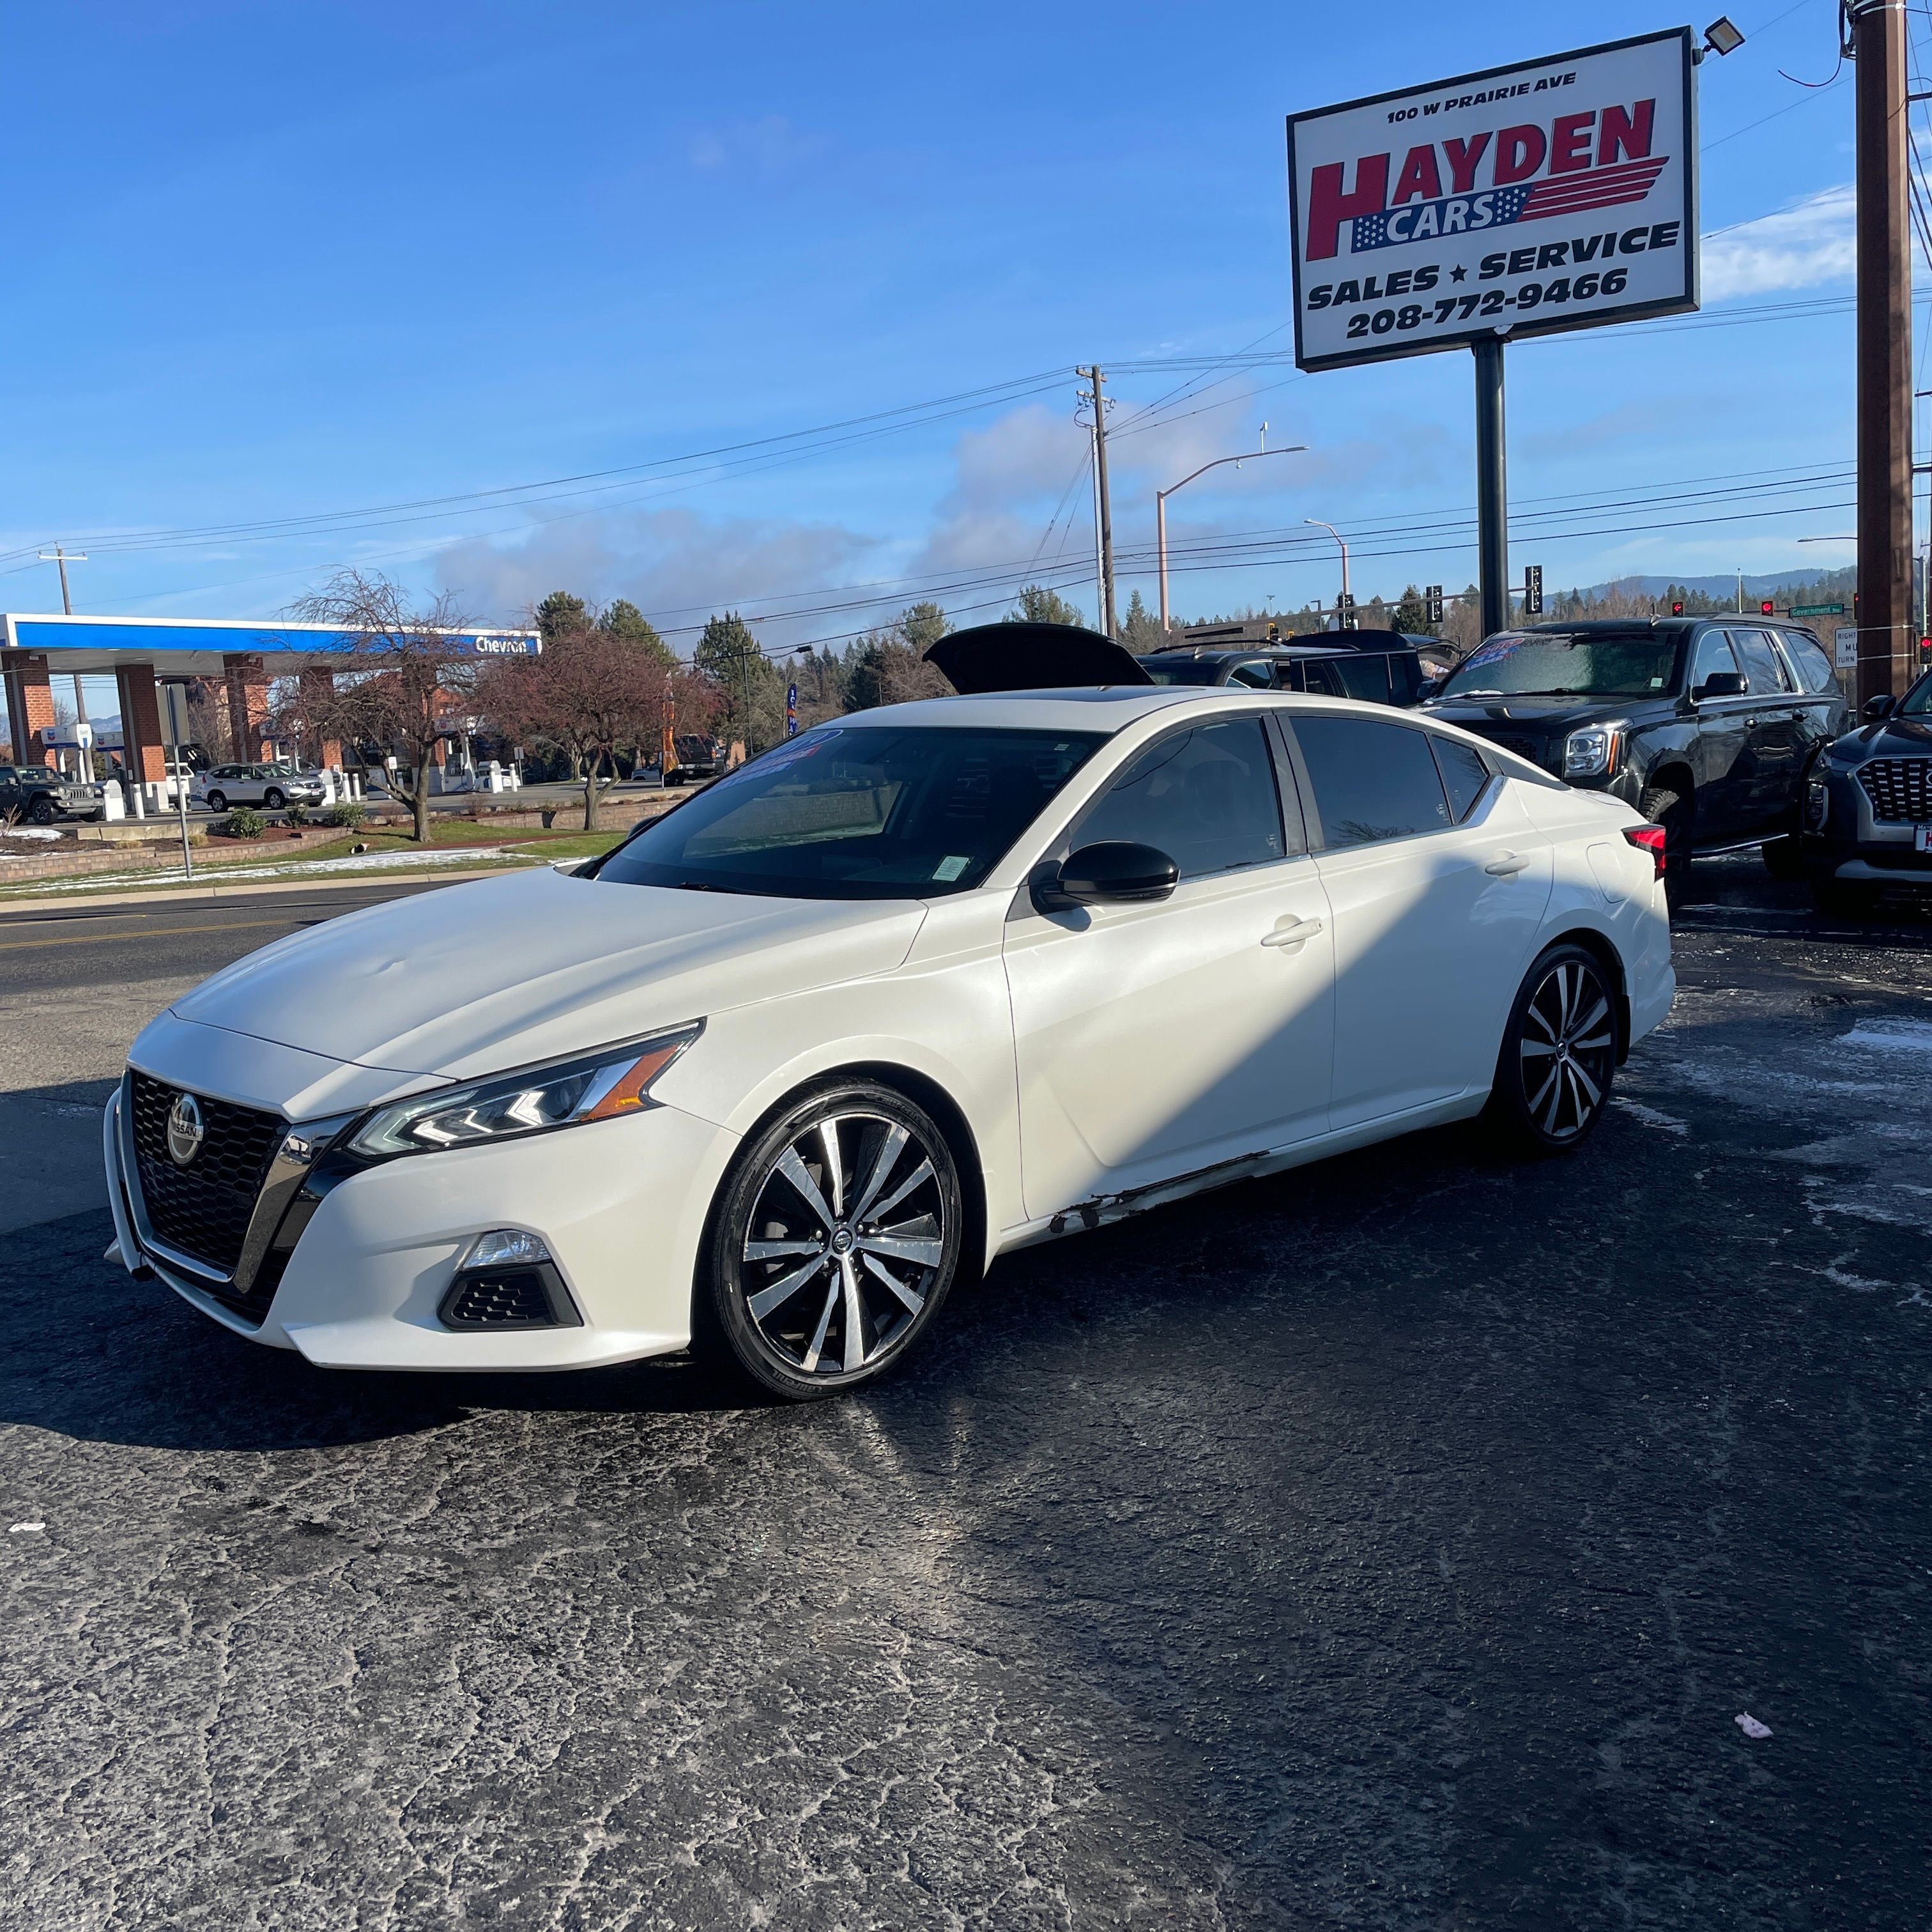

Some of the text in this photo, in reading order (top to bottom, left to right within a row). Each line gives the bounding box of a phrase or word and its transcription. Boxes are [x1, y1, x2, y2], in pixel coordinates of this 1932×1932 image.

[1387, 72, 1577, 124] 100 W PRAIRIE AVE
[1306, 98, 1656, 262] HAYDEN
[1386, 194, 1494, 243] CARS
[1307, 220, 1681, 311] SALES SERVICE
[1346, 268, 1628, 339] 208-772-9466
[1791, 606, 1831, 615] Government
[475, 636, 526, 653] Chevron
